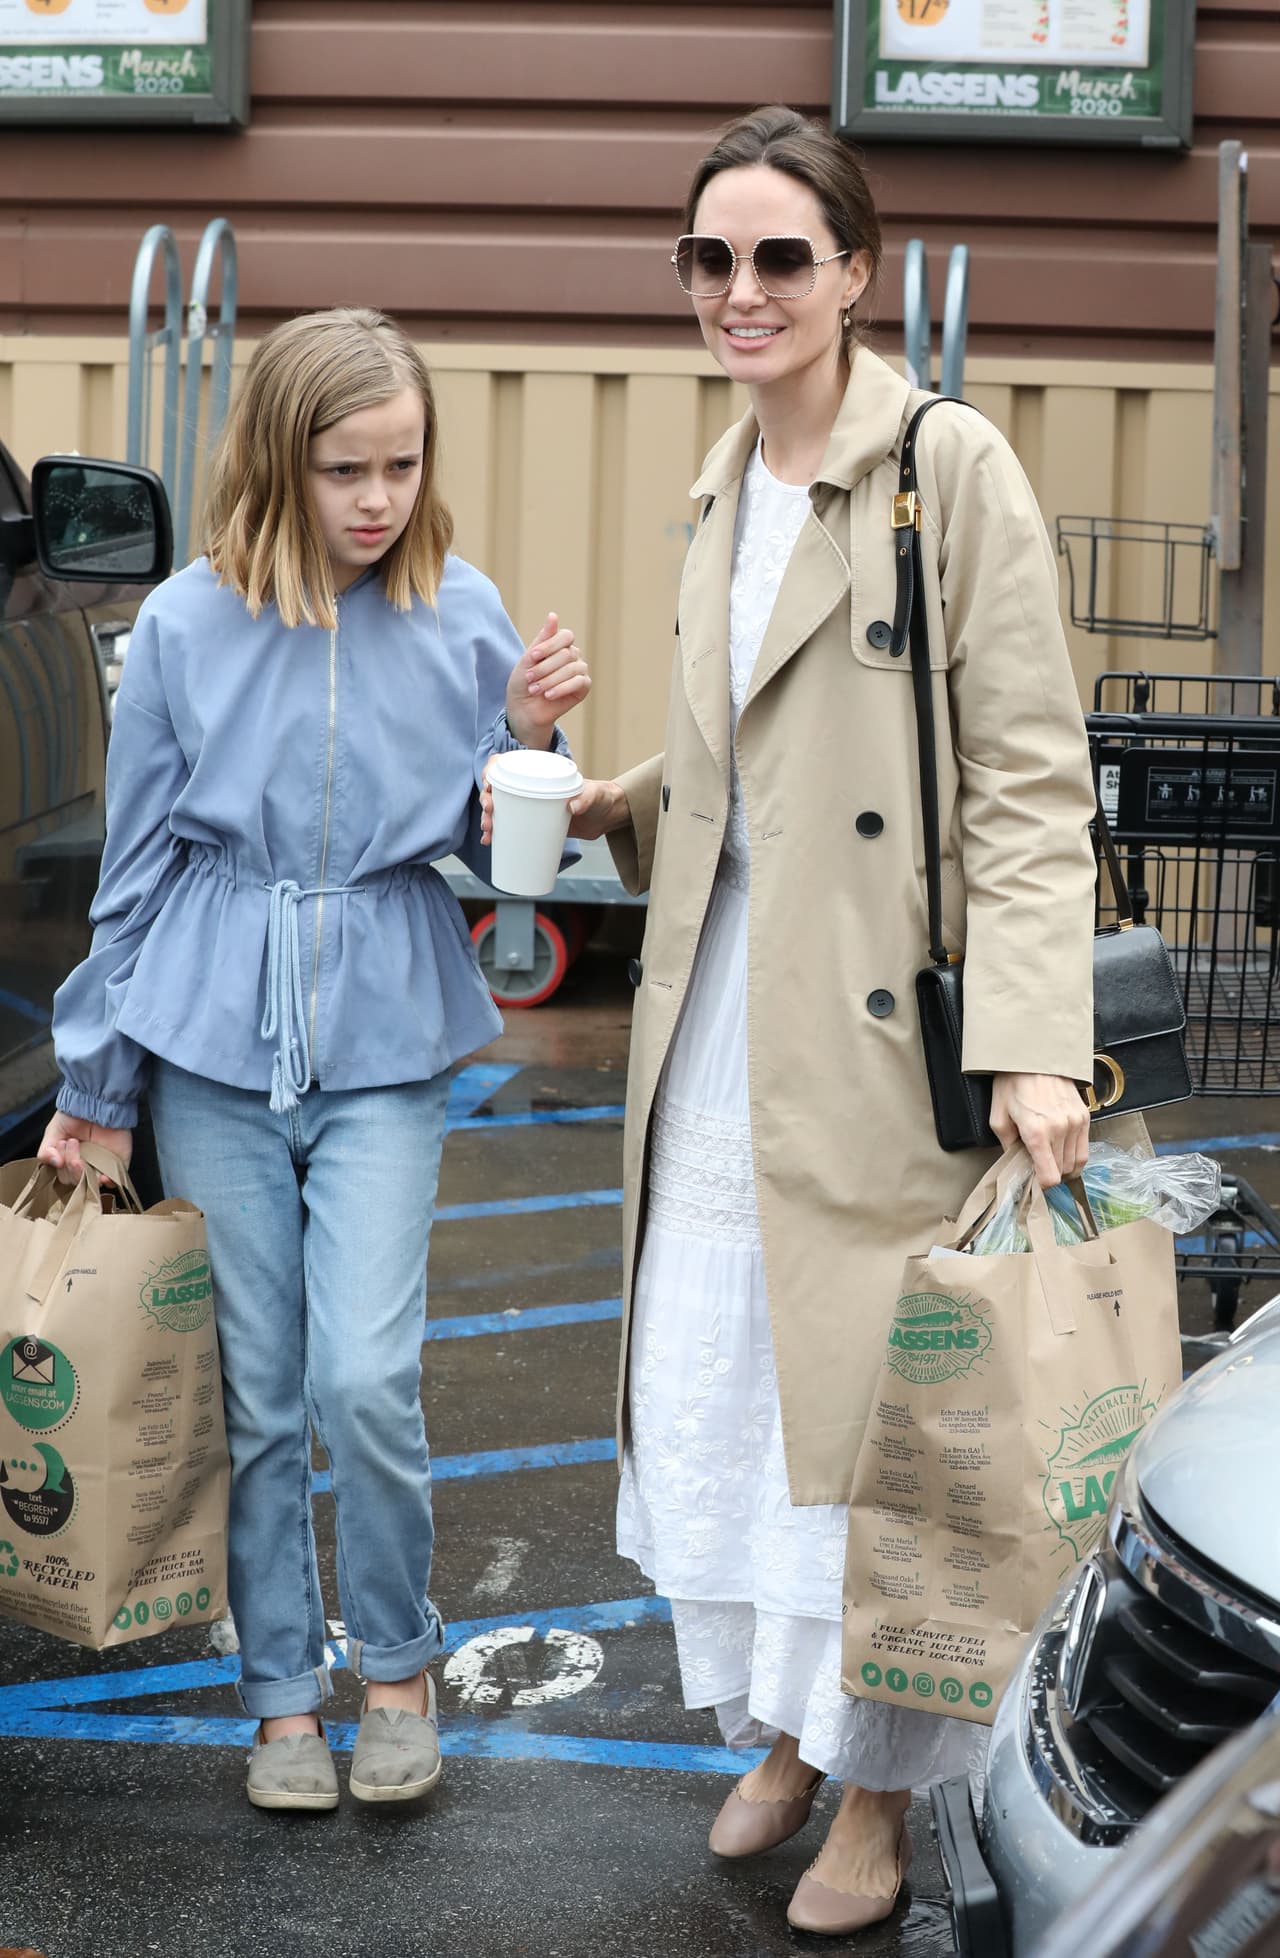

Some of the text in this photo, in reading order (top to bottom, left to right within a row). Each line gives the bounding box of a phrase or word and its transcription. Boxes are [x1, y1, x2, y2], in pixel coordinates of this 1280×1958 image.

[117, 49, 197, 77] March
[134, 77, 184, 93] 2020
[875, 71, 1039, 107] LASSENS
[1055, 70, 1137, 100] March
[1070, 99, 1122, 115] 2020
[23, 1559, 96, 1582] RECYCLED
[45, 1554, 70, 1568] 100%
[160, 1561, 185, 1573] JUICE
[36, 1573, 79, 1591] PAPER
[161, 1566, 205, 1581] LOCATIONS
[880, 1624, 986, 1647] FULL SERVICE DELI
[880, 1634, 927, 1648] ORGANIC
[930, 1642, 962, 1653] JUICE
[966, 1647, 986, 1657] BAR
[871, 1641, 986, 1667] AT SELECT LOCATIONS
